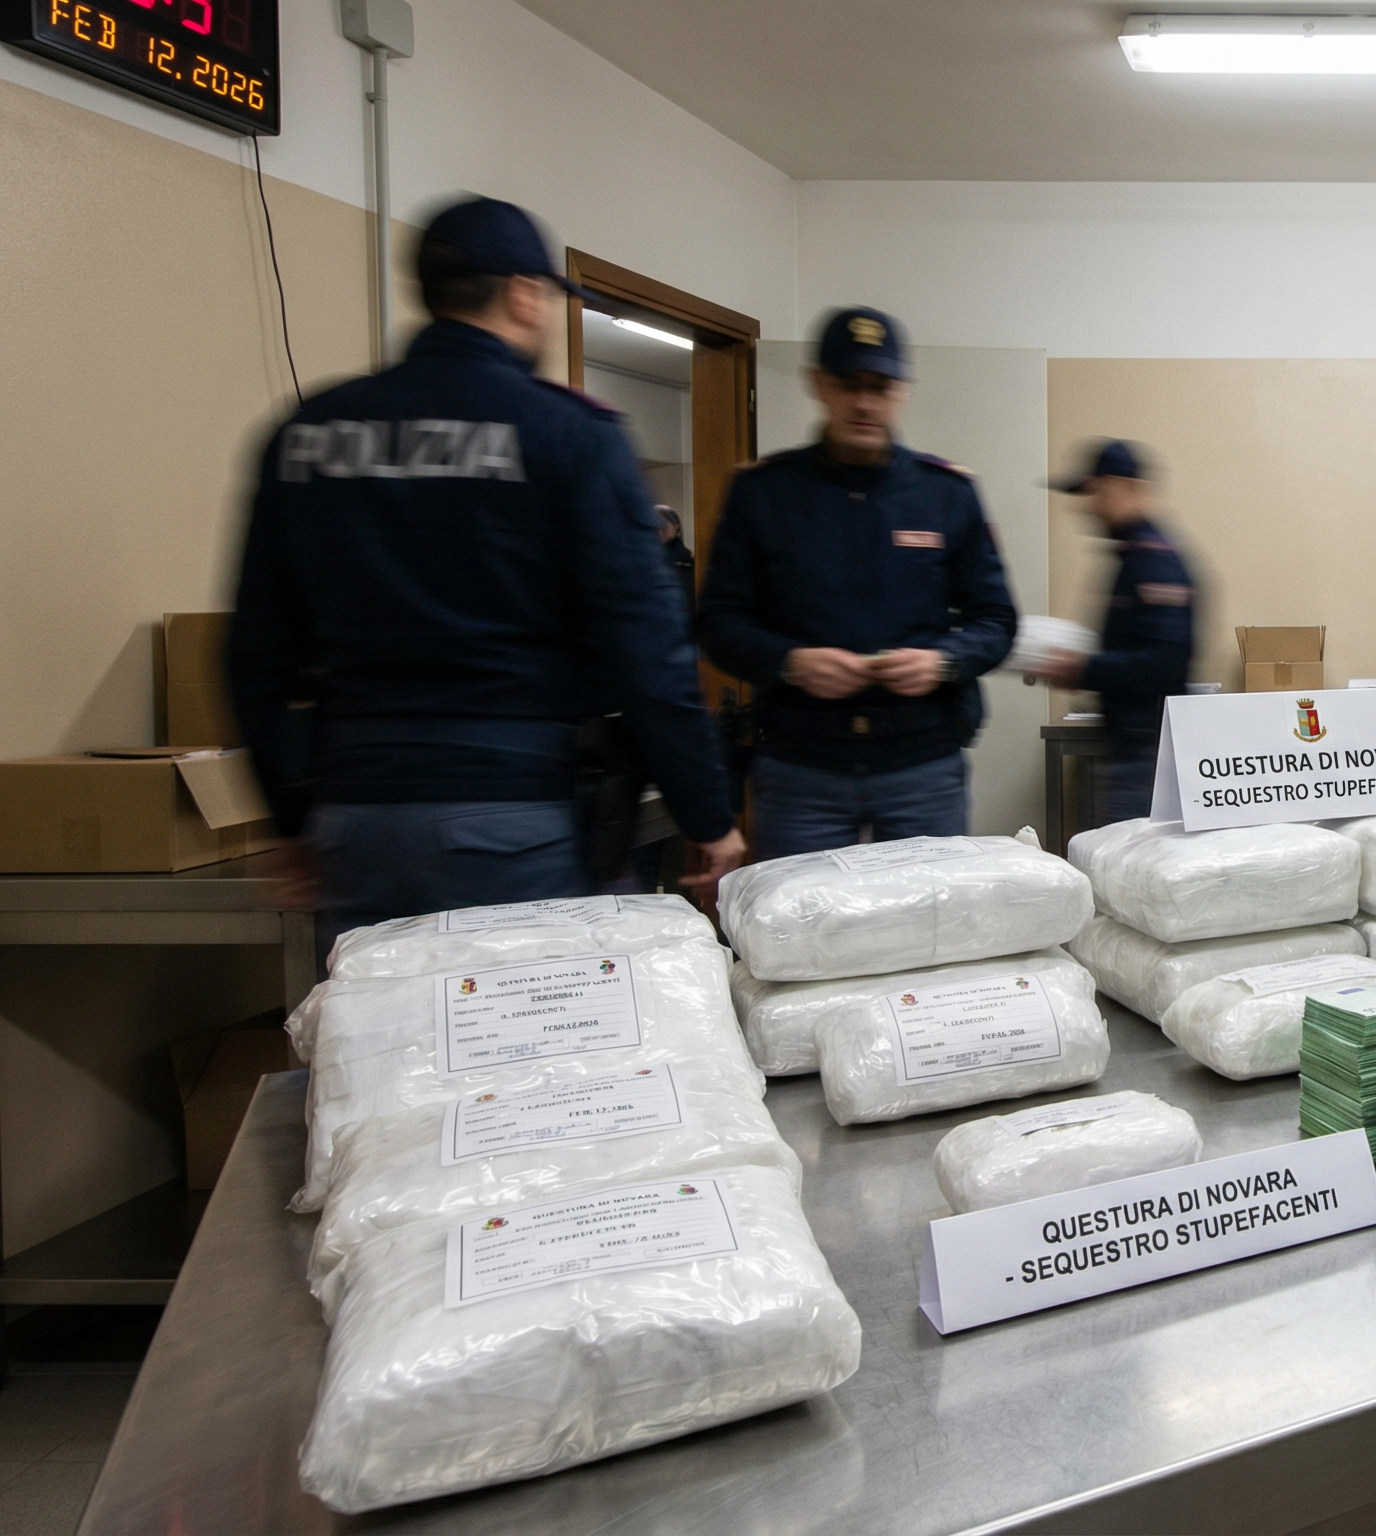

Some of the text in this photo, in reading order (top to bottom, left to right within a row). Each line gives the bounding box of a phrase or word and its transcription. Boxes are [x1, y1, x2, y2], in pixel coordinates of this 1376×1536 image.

[52, 0, 116, 49] FEB
[1198, 753, 1313, 779] QUESTURA
[1319, 751, 1339, 770] DI
[1021, 1230, 1169, 1284] SEQUESTRO
[1176, 1189, 1338, 1245] STUPEFACENTI
[1042, 1168, 1298, 1244] QUESTURA DI NOVARA
